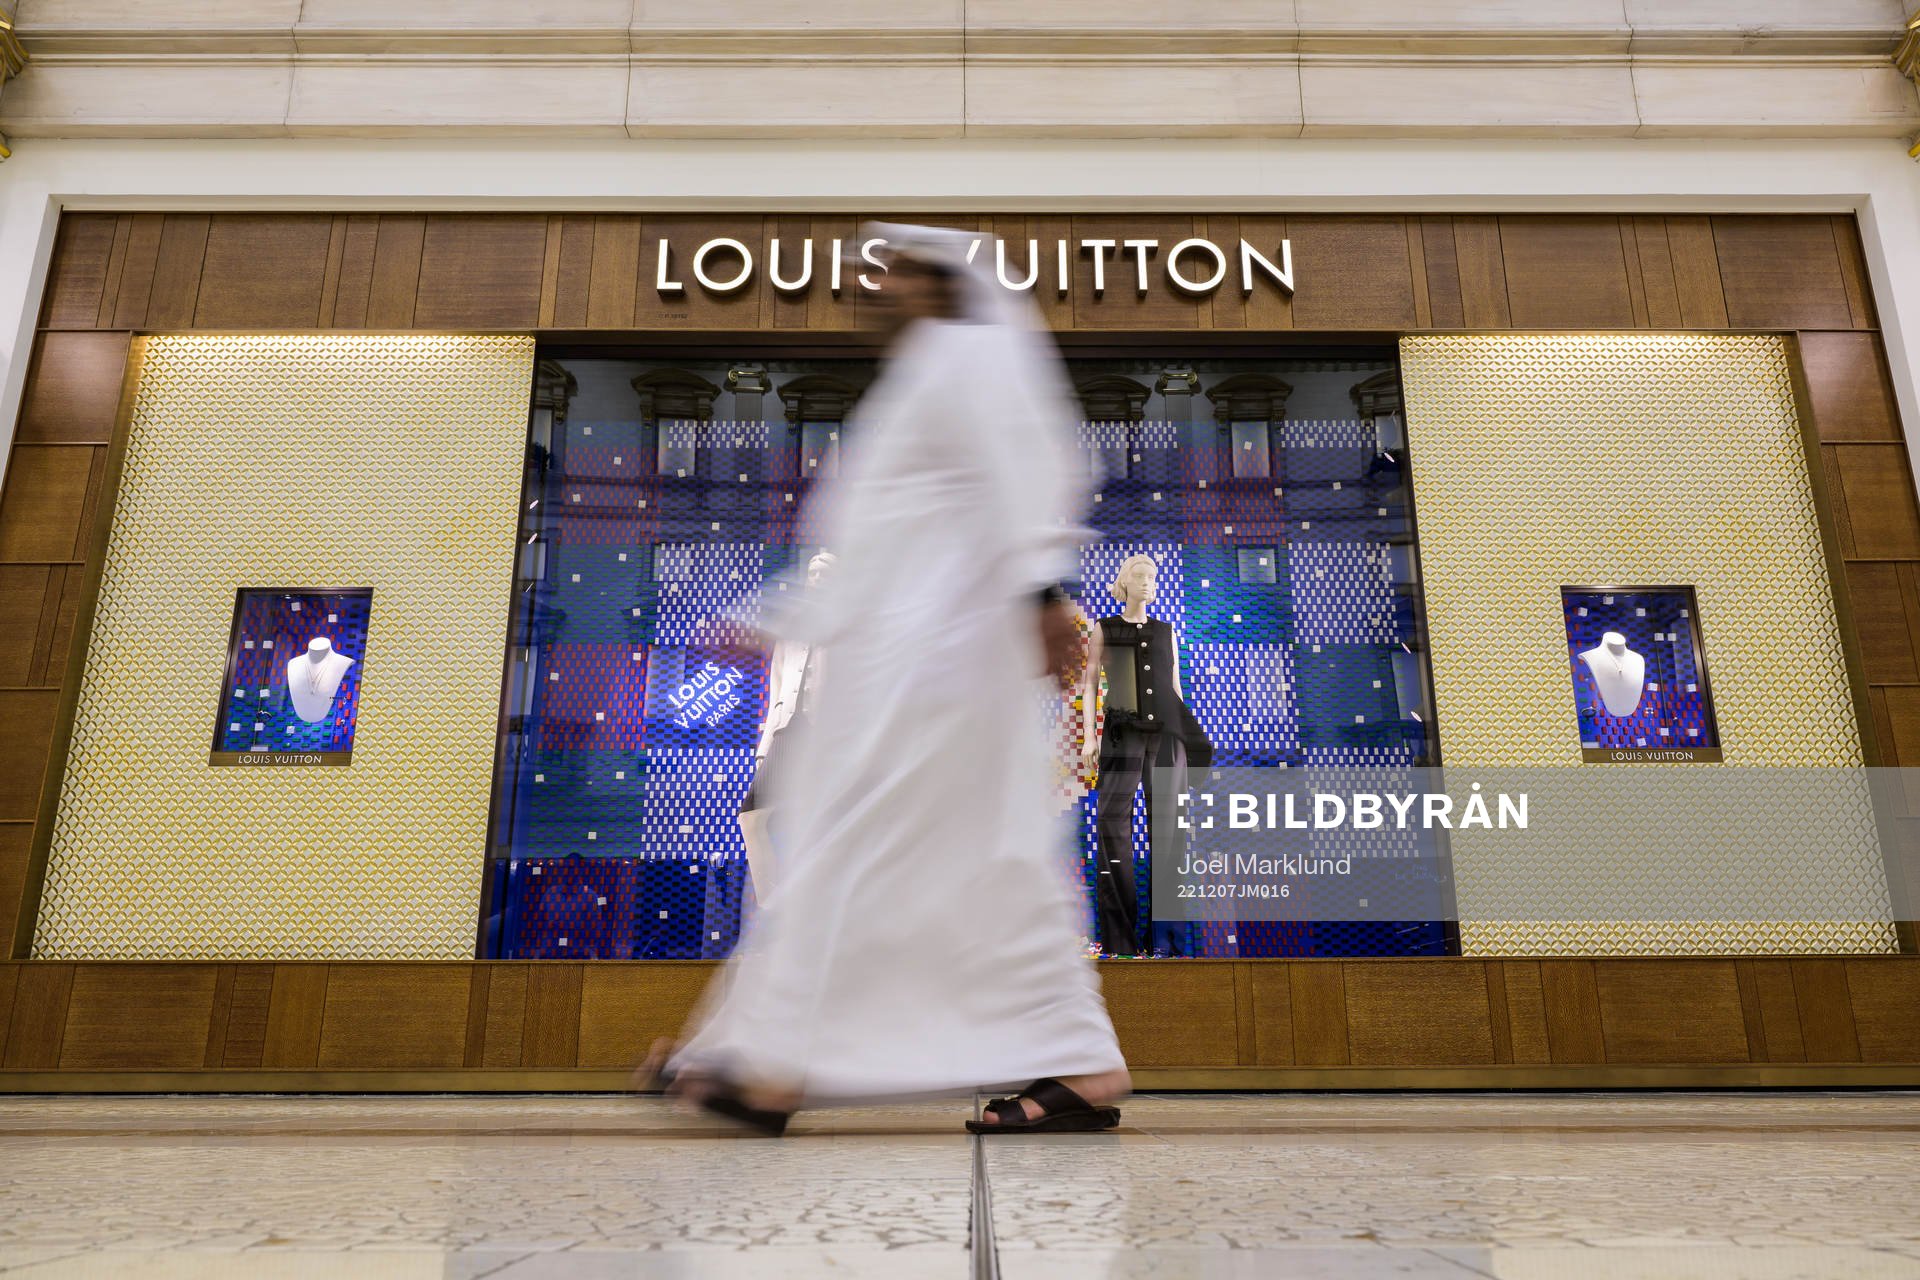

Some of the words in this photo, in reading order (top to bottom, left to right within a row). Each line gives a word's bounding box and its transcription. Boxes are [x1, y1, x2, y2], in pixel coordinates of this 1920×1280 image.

[656, 237, 889, 295] LOUIS
[965, 238, 1295, 296] UITTON
[668, 661, 720, 709] LOUIS
[673, 666, 743, 729] VUITTON
[706, 694, 740, 727] PARIS
[238, 755, 271, 764] LOUIS
[274, 754, 322, 764] VUITTON
[1611, 751, 1643, 761] LOUIS
[1646, 751, 1694, 761] VUITTON
